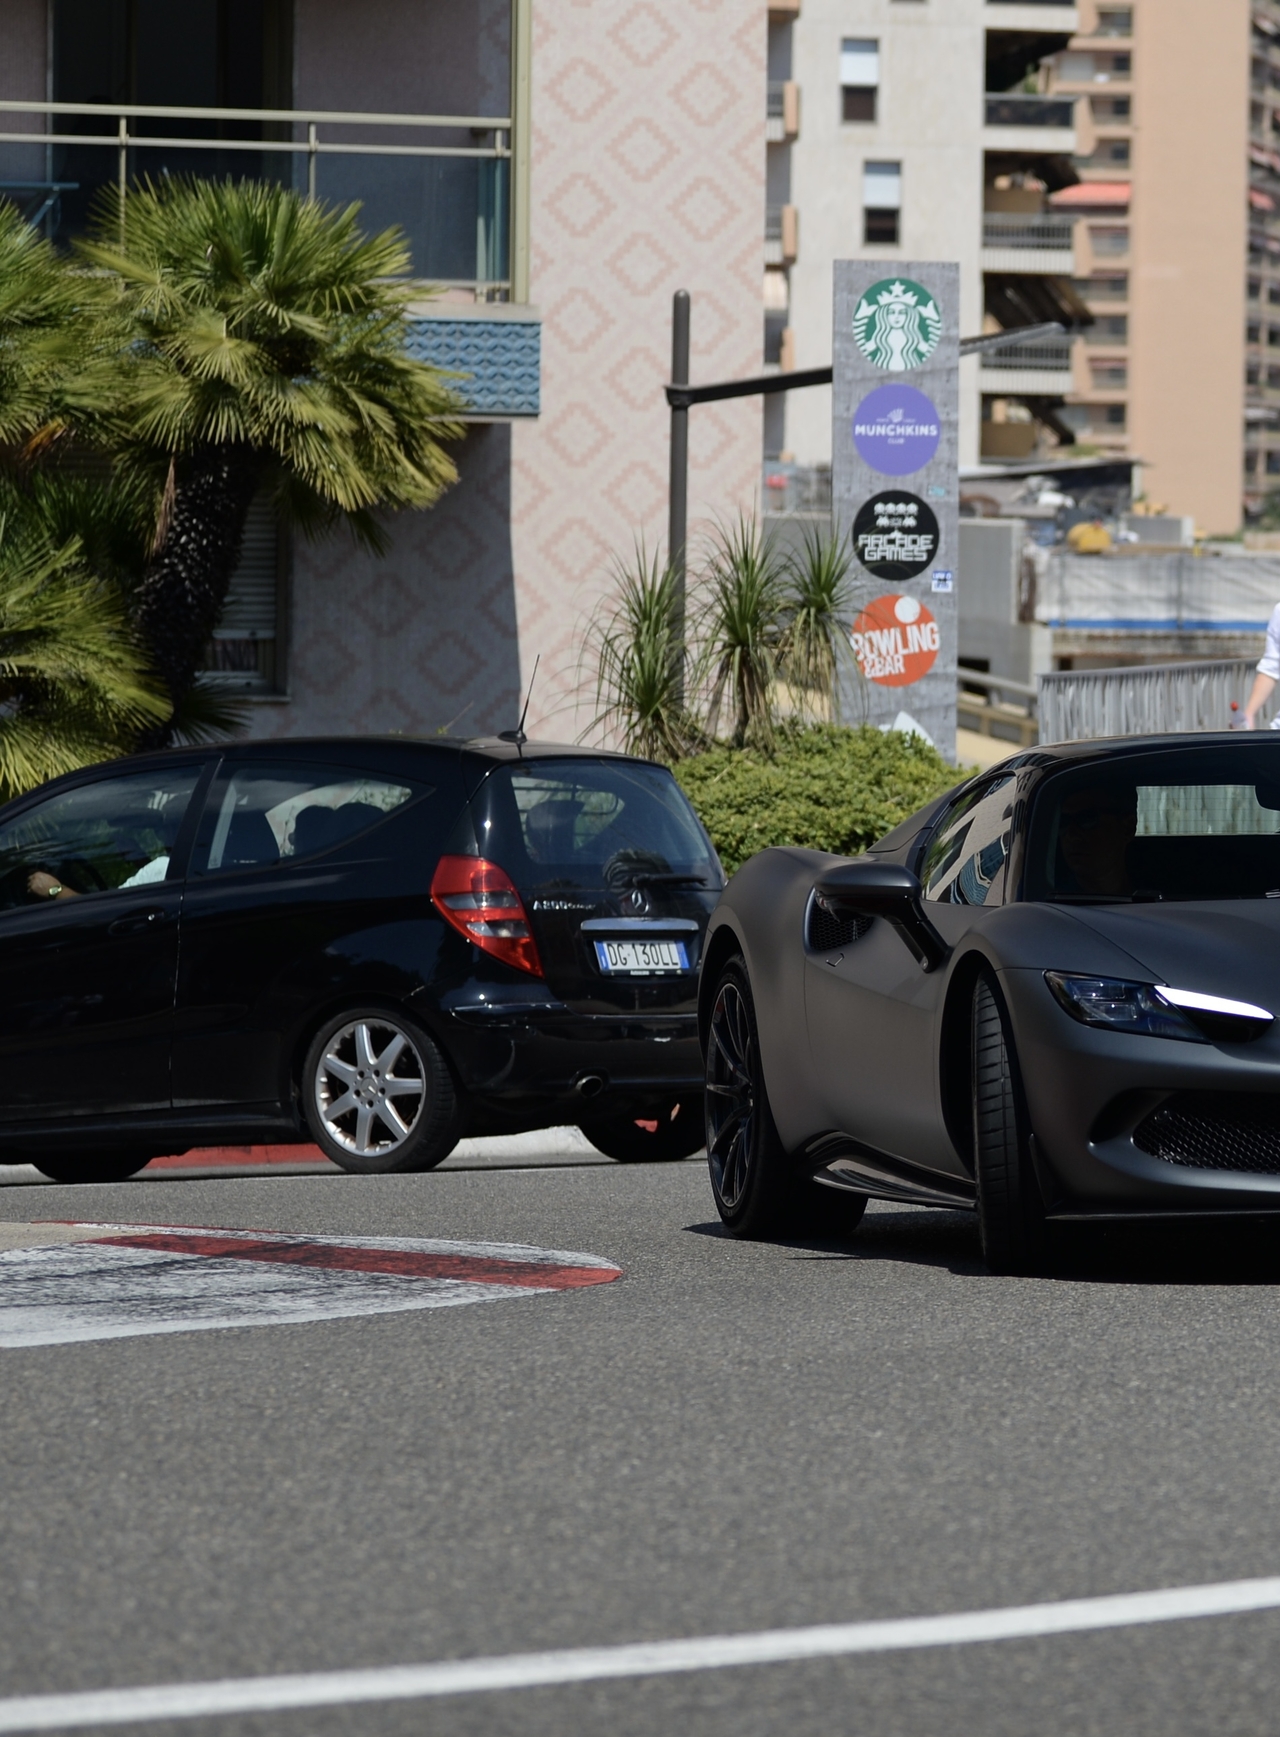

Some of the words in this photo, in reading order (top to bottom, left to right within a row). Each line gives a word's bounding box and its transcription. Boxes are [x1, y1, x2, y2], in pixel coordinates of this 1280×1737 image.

[854, 424, 938, 436] MUNCHKINS
[858, 534, 934, 550] ARCADE
[864, 547, 928, 561] GAMES
[849, 621, 940, 661] BOWLING
[606, 943, 627, 966] DG
[631, 943, 678, 966] 130LL
